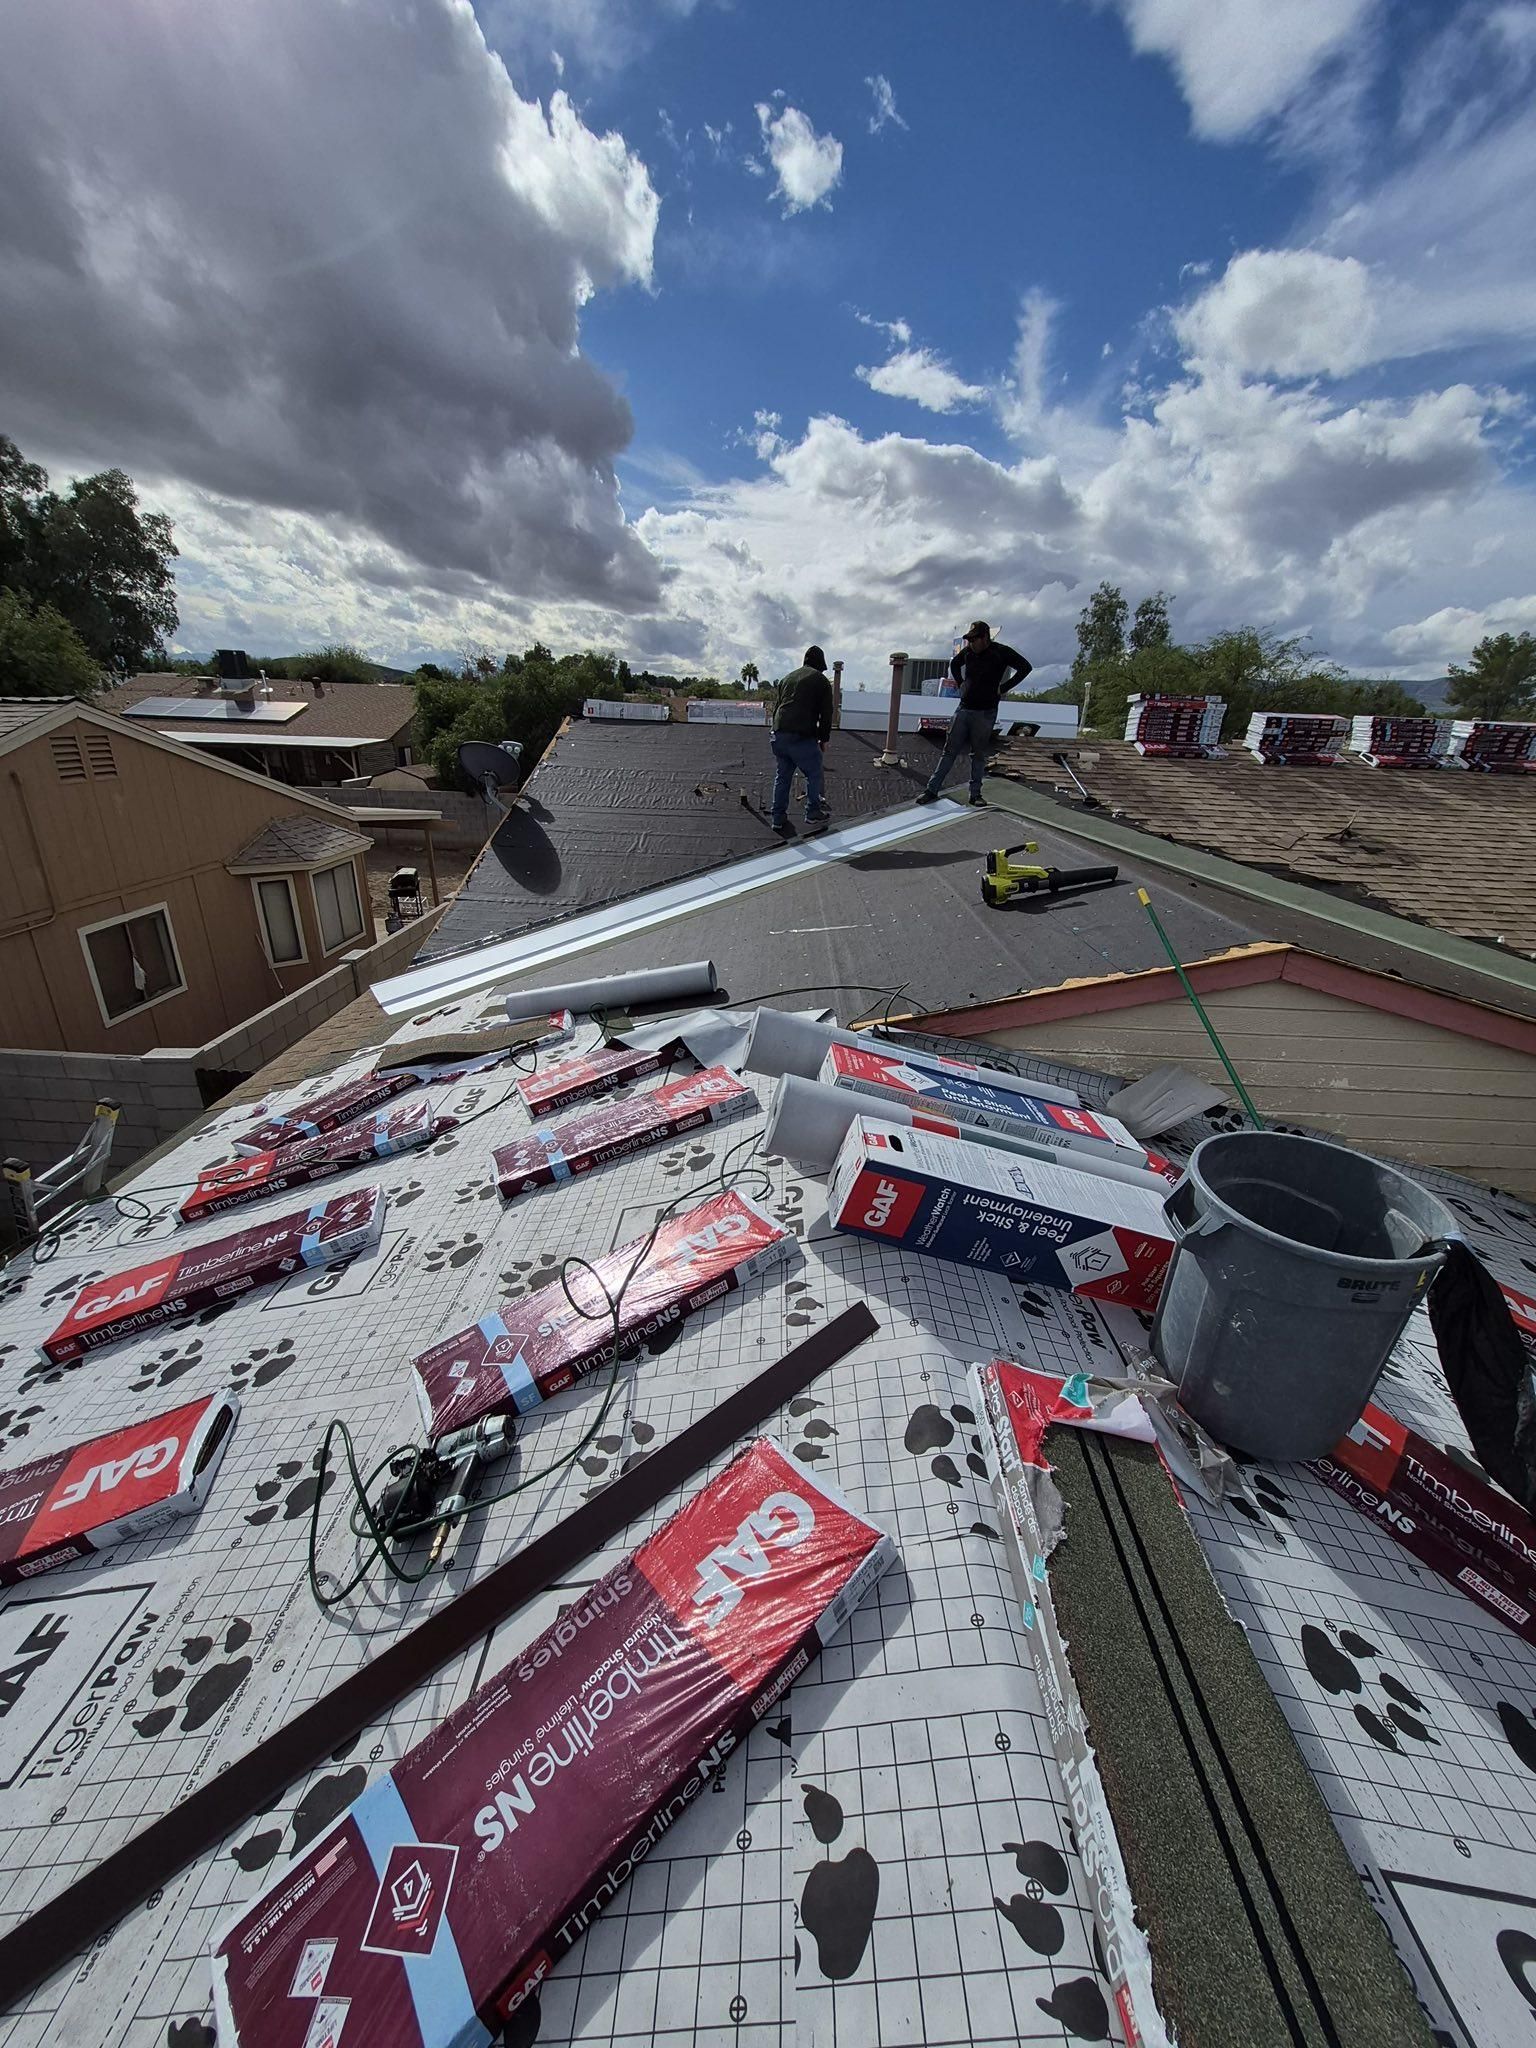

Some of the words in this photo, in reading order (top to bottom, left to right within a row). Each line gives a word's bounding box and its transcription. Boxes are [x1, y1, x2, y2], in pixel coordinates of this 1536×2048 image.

[453, 1087, 487, 1114] GAF
[538, 1105, 550, 1114] GAF
[1061, 1109, 1092, 1134] GAF
[866, 1133, 878, 1146] GAF
[575, 1160, 590, 1170] GAF
[188, 1209, 204, 1218] GAF
[863, 1179, 899, 1227] GAF
[915, 1186, 951, 1245] WeatherWatch
[962, 1193, 1073, 1231] Underlayment
[975, 1209, 1015, 1230] Stick
[1017, 1222, 1027, 1234] &
[668, 1214, 750, 1268] GAF
[1032, 1226, 1068, 1244] Peel
[167, 1268, 239, 1297] shingles
[307, 1252, 358, 1296] GA
[1337, 1277, 1401, 1292] BRUTE
[74, 1271, 170, 1320] GAF
[1068, 1292, 1108, 1350] erPaw
[56, 1343, 77, 1355] GAF
[1073, 1326, 1095, 1365] Protection
[550, 1374, 571, 1393] GAF
[50, 1436, 179, 1512] GAF
[1406, 1470, 1442, 1502] Natural
[1017, 1479, 1034, 1515] Bande
[1027, 1518, 1036, 1534] de
[692, 1491, 817, 1628] GAF
[1465, 1568, 1477, 1580] DO
[1479, 1576, 1495, 1593] NOT
[1460, 1572, 1487, 1594] STACK
[1487, 1591, 1525, 1623] PALLETS
[518, 1574, 635, 1683] shingles
[622, 1614, 663, 1652] Natural
[0, 1612, 70, 1718] AF
[185, 1779, 197, 1793] or
[193, 1738, 218, 1775] Plastic
[214, 1714, 231, 1738] Cap
[228, 1677, 252, 1714] Staples
[254, 1649, 269, 1665] Use
[322, 1521, 340, 1548] Grapas
[1033, 1653, 1046, 1690] Strip
[61, 1705, 115, 1777] Premium
[110, 1667, 138, 1703] Roof
[133, 1636, 160, 1670] Deck
[156, 1576, 201, 1634] Protection
[756, 1688, 781, 1717] STACK
[779, 1656, 810, 1691] PALLETS
[475, 1708, 497, 1728] natural
[476, 1697, 492, 1713] value
[1043, 1690, 1059, 1745] Starter
[454, 1721, 474, 1740] stylish
[463, 1726, 478, 1740] look
[441, 1744, 459, 1762] wood
[485, 1742, 536, 1791] Shingles
[421, 1760, 443, 1781] shakes
[292, 1876, 317, 1902] MADE
[266, 1910, 285, 1929] THE
[282, 1899, 294, 1912] IN
[241, 1926, 272, 1957] U.S.A.
[76, 1955, 100, 1985] Use
[508, 1960, 548, 2013] GAF
